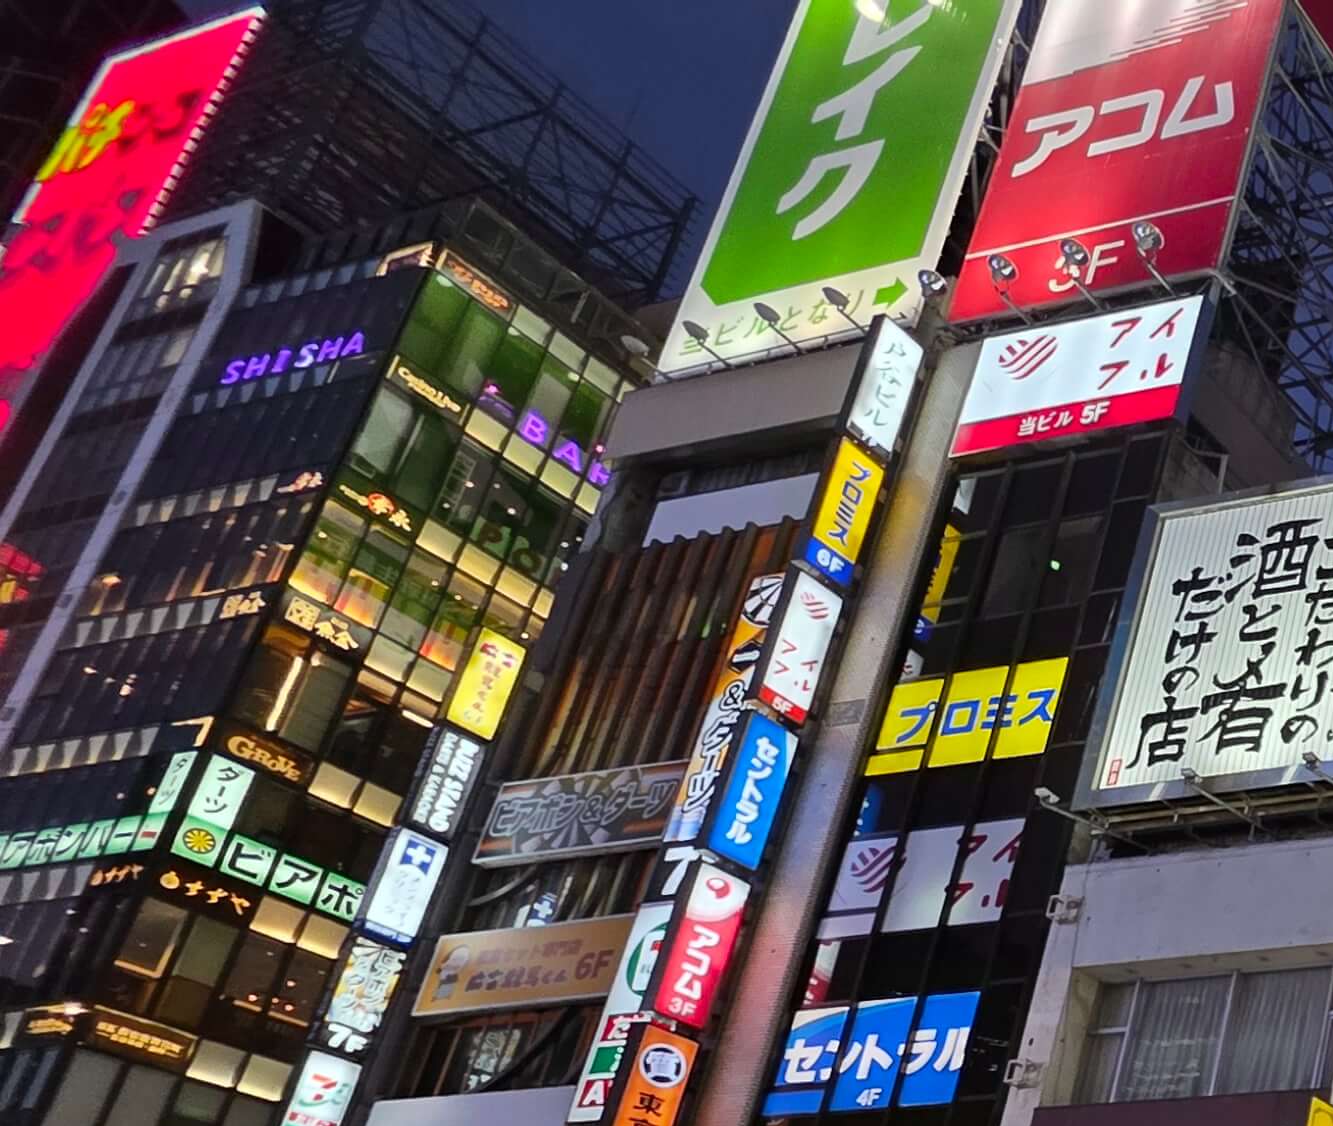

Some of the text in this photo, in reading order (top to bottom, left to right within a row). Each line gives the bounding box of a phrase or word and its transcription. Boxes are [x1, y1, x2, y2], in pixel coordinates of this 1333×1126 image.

[1011, 75, 1234, 178] アコム
[221, 331, 366, 386] SHISHA
[1017, 401, 1111, 437] 当ビル 5F
[827, 459, 873, 547] プロミス
[815, 547, 845, 572] 6F
[1126, 566, 1234, 770] だけの店
[897, 689, 1056, 743] プロミス
[203, 766, 241, 815] ダーツ
[725, 736, 781, 846] セントラル
[680, 925, 719, 998] アコム
[666, 997, 697, 1018] 3F
[783, 1022, 967, 1086] セントラル
[855, 1088, 883, 1109] 4F
